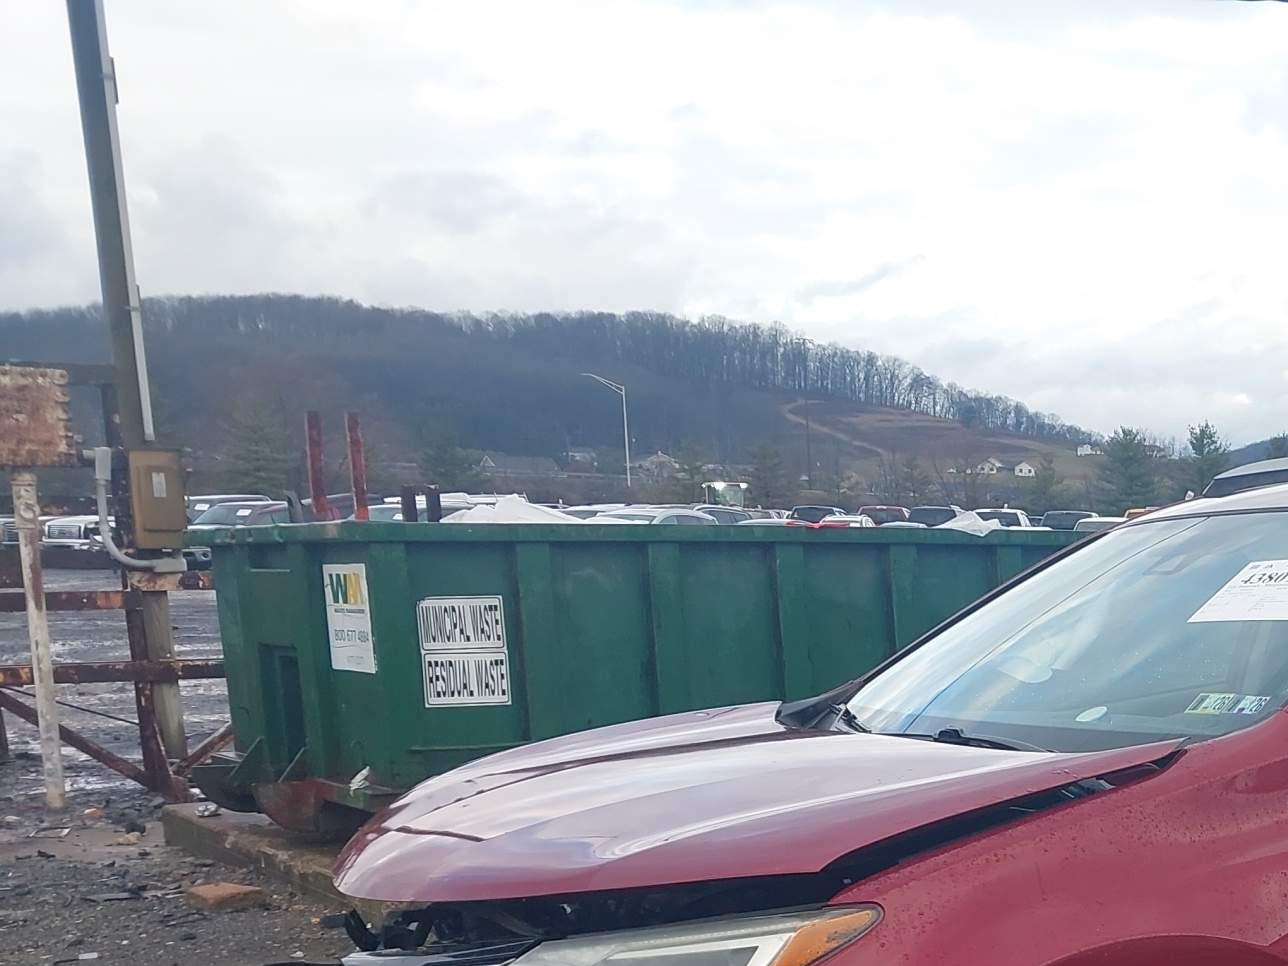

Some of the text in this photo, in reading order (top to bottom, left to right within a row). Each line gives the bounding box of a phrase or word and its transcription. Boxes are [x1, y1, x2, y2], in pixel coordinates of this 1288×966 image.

[421, 604, 501, 643] MUNICIPAL WASTE
[427, 659, 506, 698] RESIDUAL WASTE
